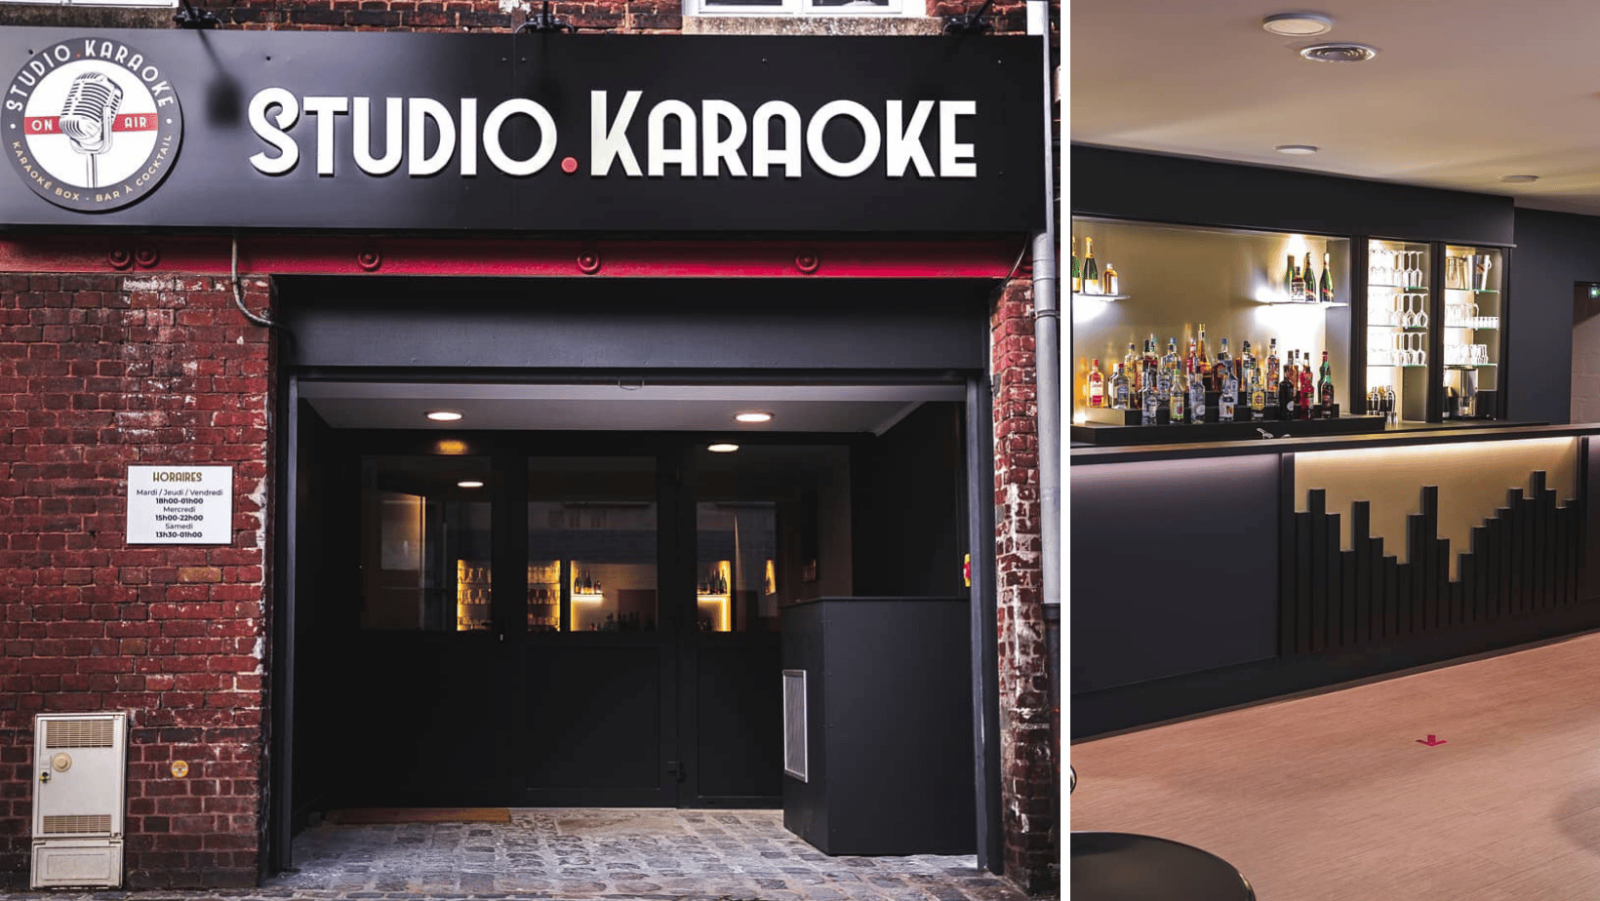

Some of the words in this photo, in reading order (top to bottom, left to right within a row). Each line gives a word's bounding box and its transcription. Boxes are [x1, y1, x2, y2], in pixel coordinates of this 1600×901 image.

[85, 40, 174, 108] KARAOKE
[31, 119, 53, 131] ON
[124, 117, 147, 128] AIR
[12, 141, 52, 190] KARAOKE
[55, 187, 80, 201] BOX
[95, 190, 120, 202] BAR
[136, 135, 172, 186] COCKTAIL
[152, 471, 203, 483] HORAIRES
